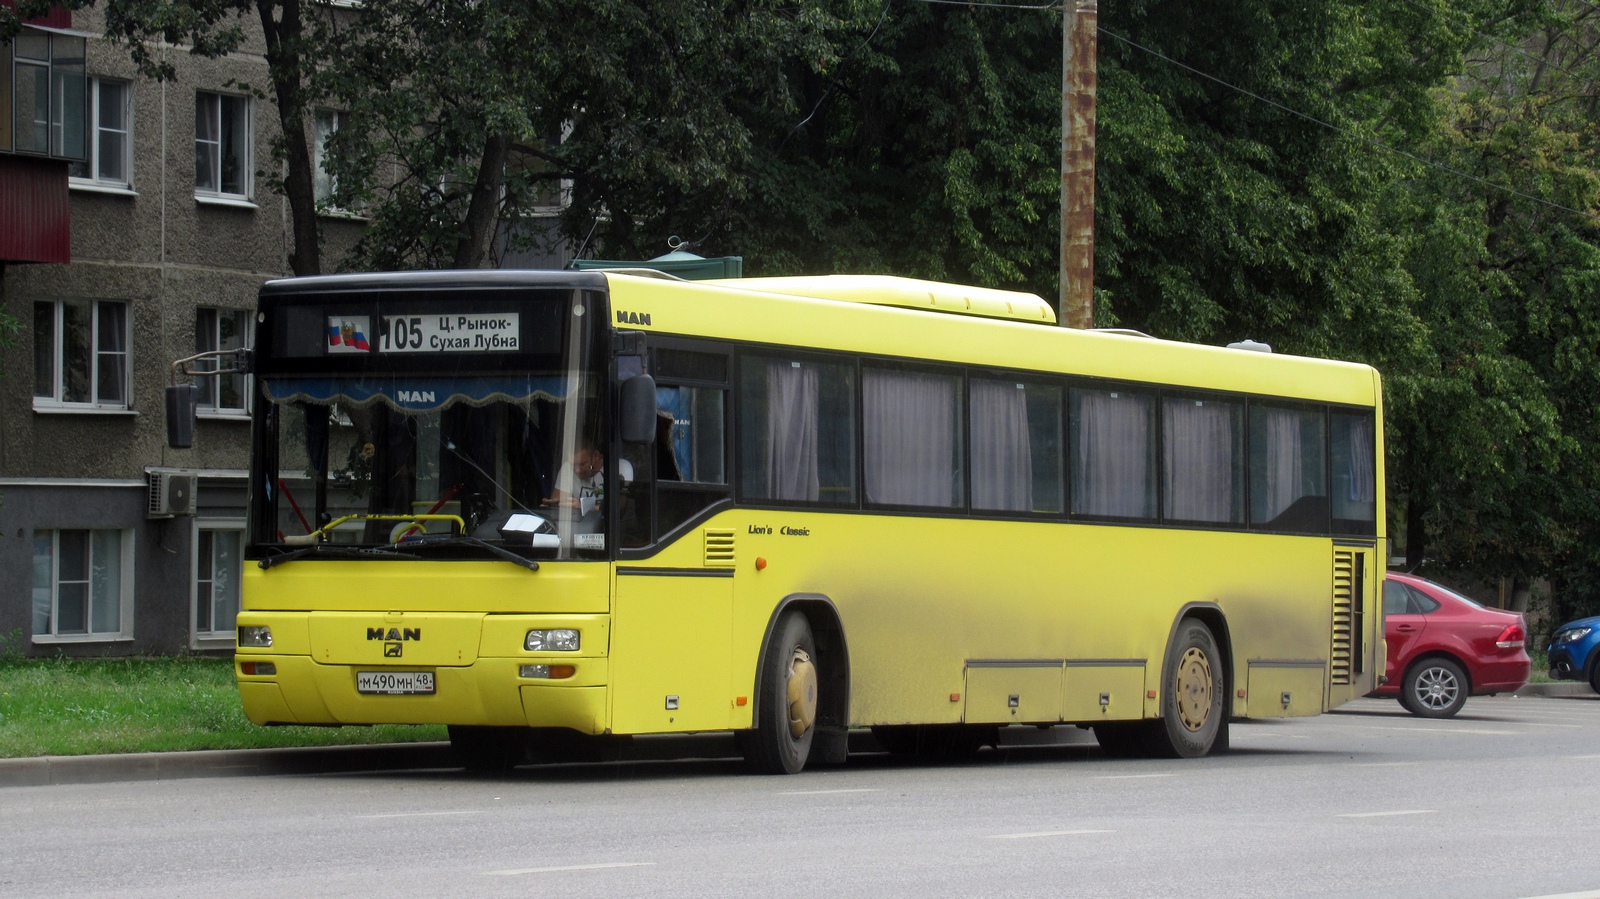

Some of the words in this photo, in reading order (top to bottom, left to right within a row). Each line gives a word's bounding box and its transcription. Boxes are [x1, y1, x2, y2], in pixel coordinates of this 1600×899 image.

[439, 316, 454, 333] Ц.
[458, 316, 511, 330] Рынок-
[617, 310, 651, 326] MAN
[383, 318, 423, 349] 105
[430, 334, 470, 351] Сухая
[474, 333, 517, 351] Лубна
[398, 390, 436, 402] MAN
[748, 524, 773, 535] Lion's
[780, 525, 810, 537] Classic
[366, 627, 421, 641] MAN
